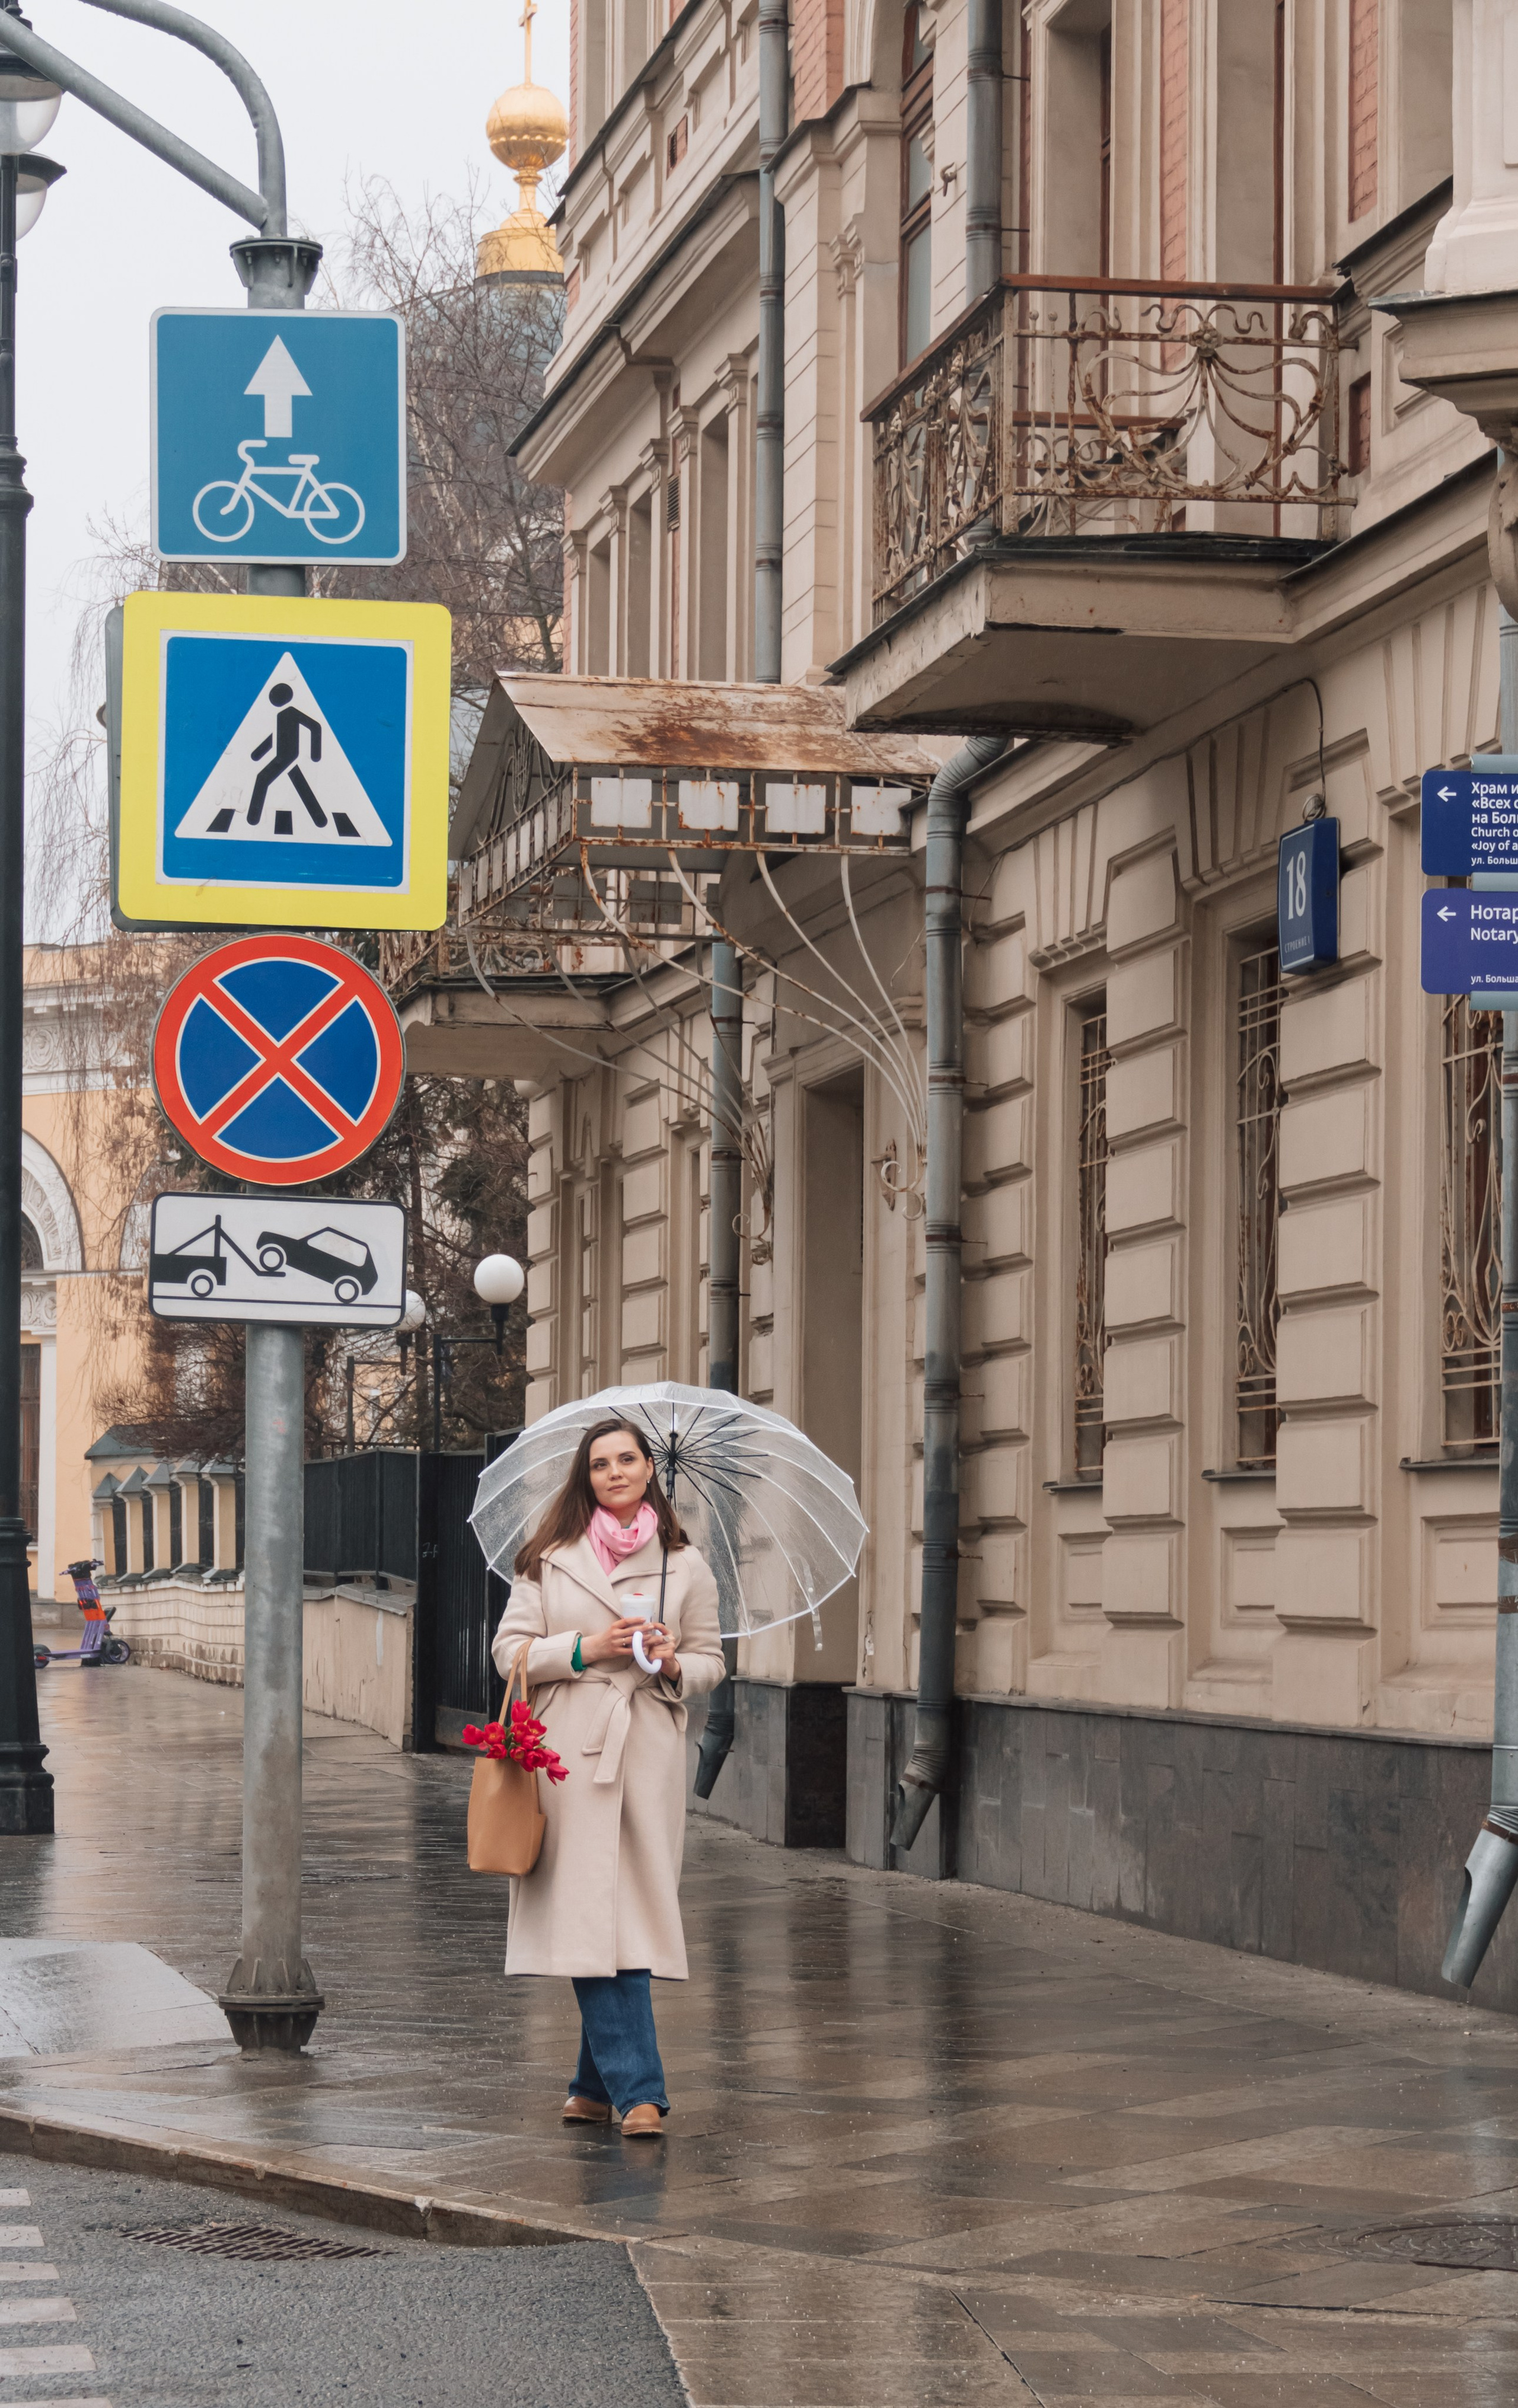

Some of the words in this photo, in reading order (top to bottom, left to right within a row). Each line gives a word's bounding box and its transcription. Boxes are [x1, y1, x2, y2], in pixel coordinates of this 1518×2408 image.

[1471, 782, 1507, 797] Храм
[1471, 797, 1511, 809] «Всех
[1472, 814, 1488, 824] на
[1492, 812, 1518, 824] Бол
[1471, 827, 1510, 837] Church
[1471, 840, 1495, 853] «Joy
[1498, 840, 1510, 850] of
[1471, 857, 1485, 866] ул.
[1286, 851, 1306, 920] 18
[1471, 927, 1518, 944] Notary
[1284, 936, 1307, 953] СТРОЕНИЕ
[1471, 975, 1484, 984] ул.
